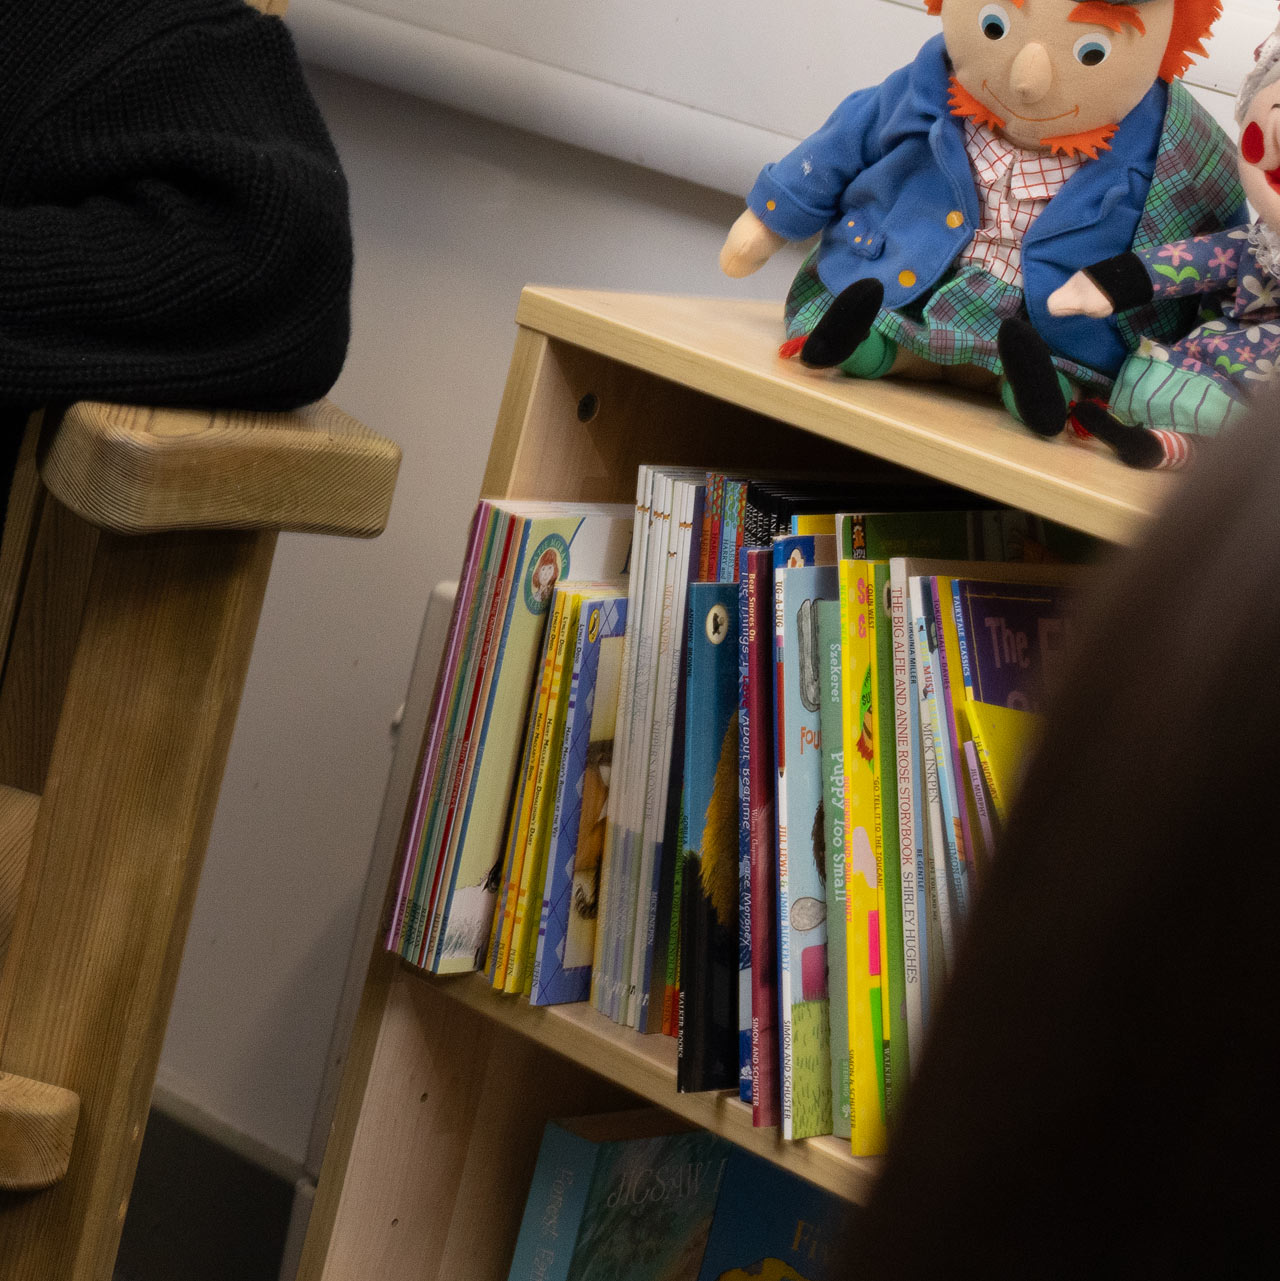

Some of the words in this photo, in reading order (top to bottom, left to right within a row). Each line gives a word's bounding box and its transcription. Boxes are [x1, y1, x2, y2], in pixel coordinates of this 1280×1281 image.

[747, 573, 756, 593] Bear
[891, 587, 904, 613] THE
[747, 597, 756, 627] Snores
[775, 581, 783, 627] UG-A-LUG
[867, 609, 875, 630] WEST
[687, 607, 695, 643] ANTHONY
[747, 629, 756, 642] On
[892, 615, 905, 639] BIG
[953, 595, 965, 637] FAIRYTALE
[959, 640, 970, 677] CLASSICS
[686, 647, 694, 677] BROWNE
[893, 640, 906, 676] ALFIE
[933, 600, 946, 654] TOKUDA-HALL
[941, 662, 952, 690] DAVIES
[909, 657, 917, 684] MILLER
[922, 664, 934, 695] MUST
[894, 678, 907, 706] AND
[740, 715, 749, 760] About
[895, 708, 909, 746] ANNIE
[920, 721, 935, 754] MICK
[829, 751, 844, 809] Puppy
[897, 749, 911, 784] ROSE
[926, 757, 942, 804] INKPEN
[970, 768, 979, 783] JILL
[644, 768, 657, 820] MONSTER
[973, 784, 987, 818] MURPHY
[751, 808, 759, 831] Wilson
[778, 825, 787, 845] JILL
[832, 817, 845, 847] Too
[875, 823, 881, 832] TO
[898, 786, 913, 865] STORYBOOK
[779, 847, 788, 877] LEWIS
[915, 848, 923, 858] BE
[945, 840, 963, 876] SIMON
[833, 853, 846, 902] Small
[916, 860, 925, 892] GENTLE!
[670, 890, 682, 928] ADRIAN
[780, 891, 789, 922] SIMON
[902, 871, 916, 927] SHIRLEY
[740, 890, 752, 946] Moroney
[665, 930, 679, 981] REYNOLDS
[904, 929, 918, 984] HUGHES
[751, 1017, 760, 1045] SIMON
[783, 1020, 791, 1049] SIMON
[752, 1047, 760, 1064] AND
[783, 1052, 792, 1072] AND
[882, 1047, 893, 1085] WALKER
[751, 1065, 761, 1107] SCHUSTER
[842, 1060, 850, 1097] STERLING
[782, 1075, 792, 1120] SCHUSTER
[849, 1087, 857, 1129] SCHUSTER
